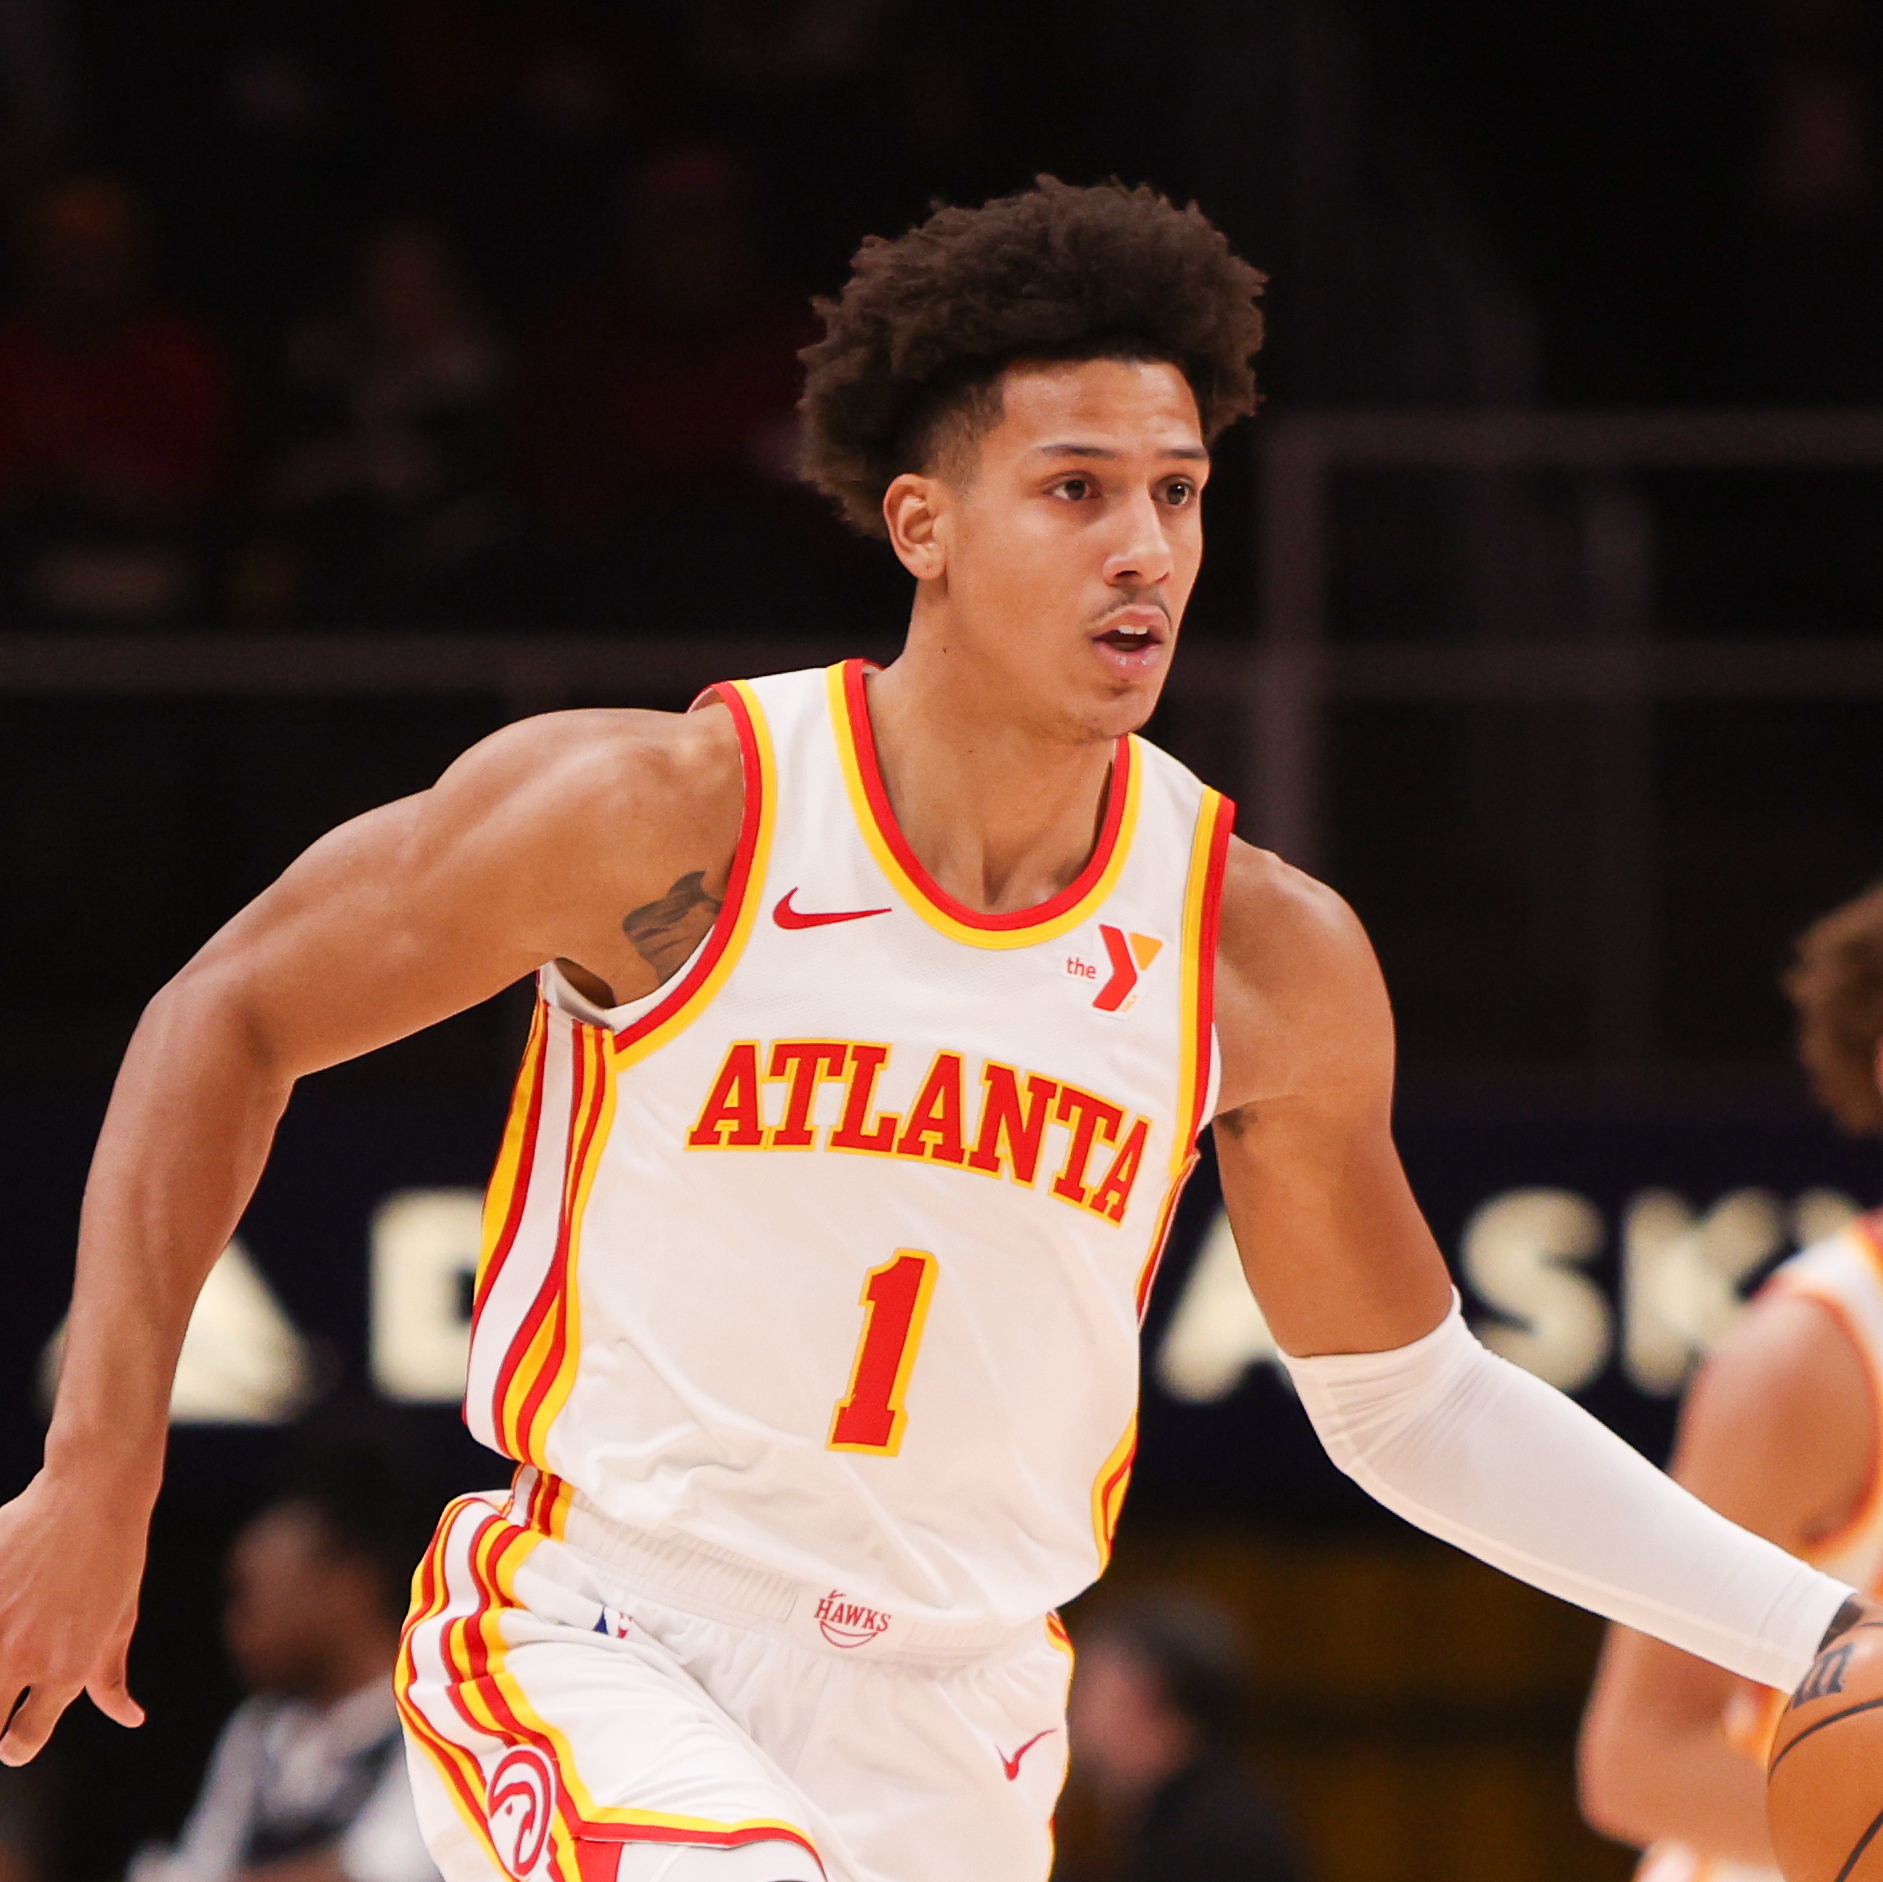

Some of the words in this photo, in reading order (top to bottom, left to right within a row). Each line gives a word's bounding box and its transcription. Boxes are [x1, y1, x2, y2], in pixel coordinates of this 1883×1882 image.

[1066, 957, 1097, 980] the
[684, 1038, 1152, 1229] ATLANTA
[825, 1247, 940, 1457] 1
[814, 1598, 892, 1632] HAWKS
